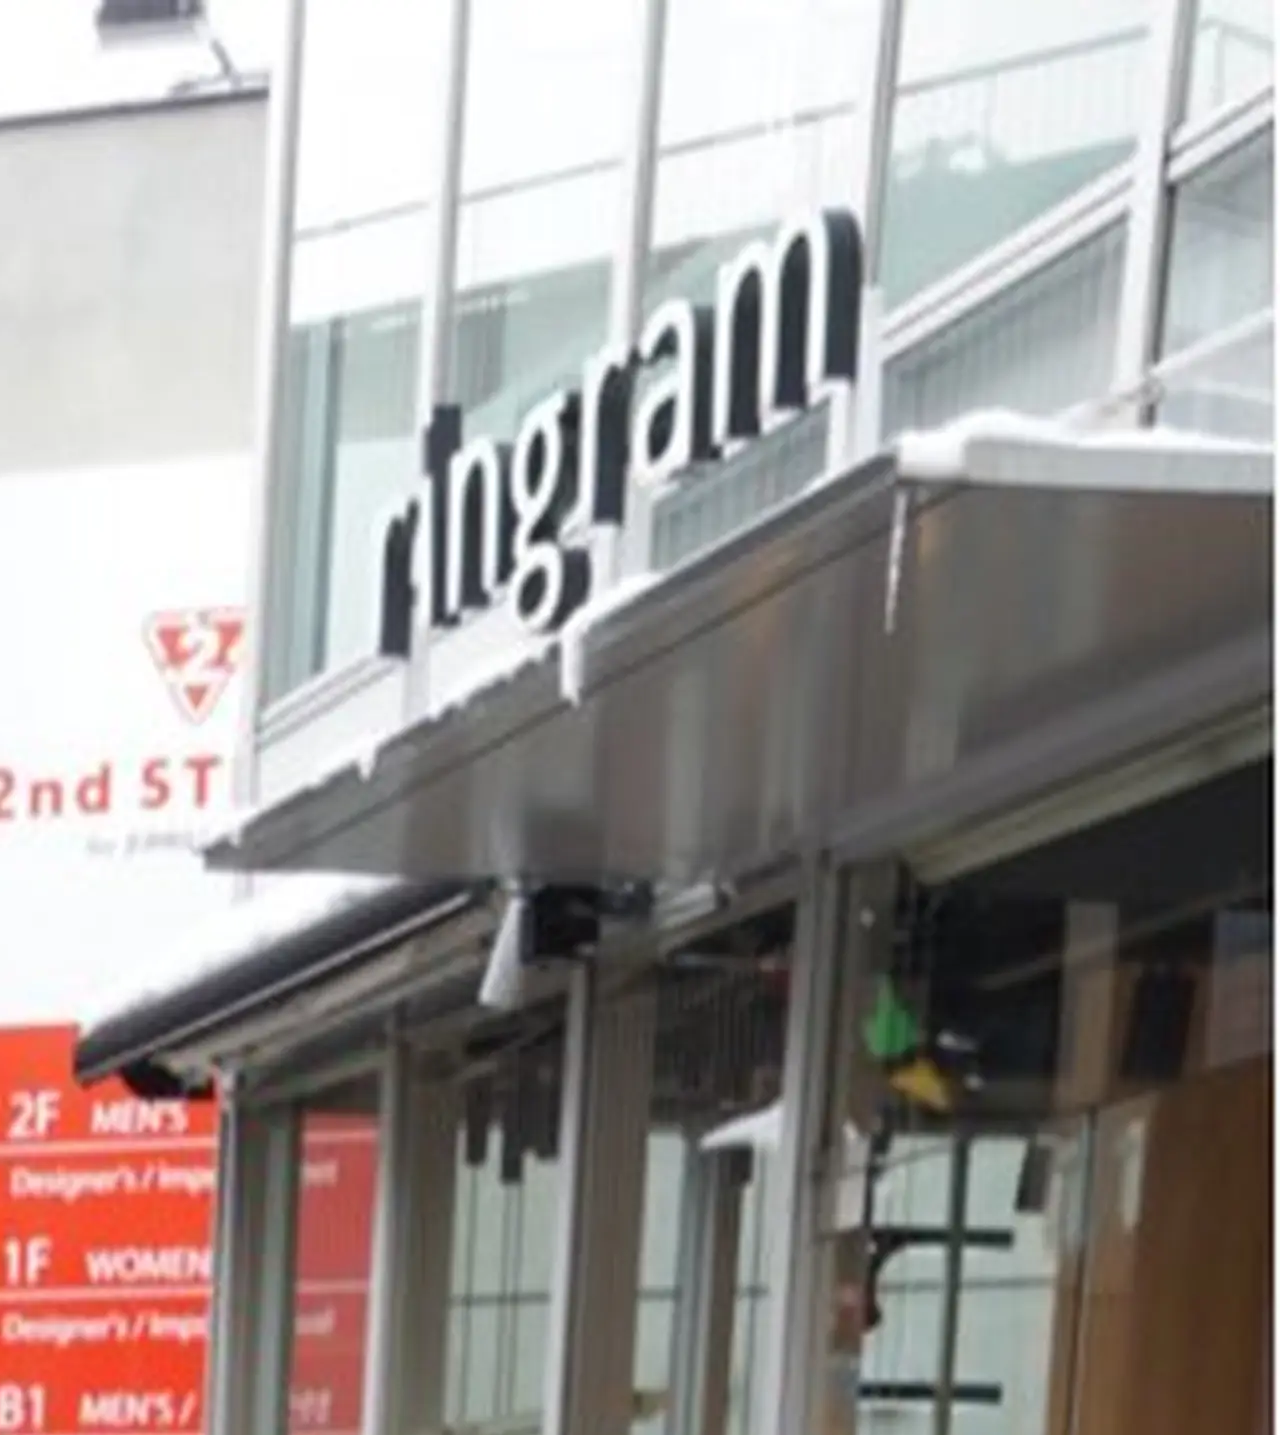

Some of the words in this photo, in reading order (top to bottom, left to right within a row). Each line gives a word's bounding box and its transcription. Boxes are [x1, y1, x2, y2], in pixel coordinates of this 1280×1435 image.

[376, 207, 863, 658] ringram
[8, 1090, 61, 1139] 2F
[4, 1234, 52, 1286] 1F
